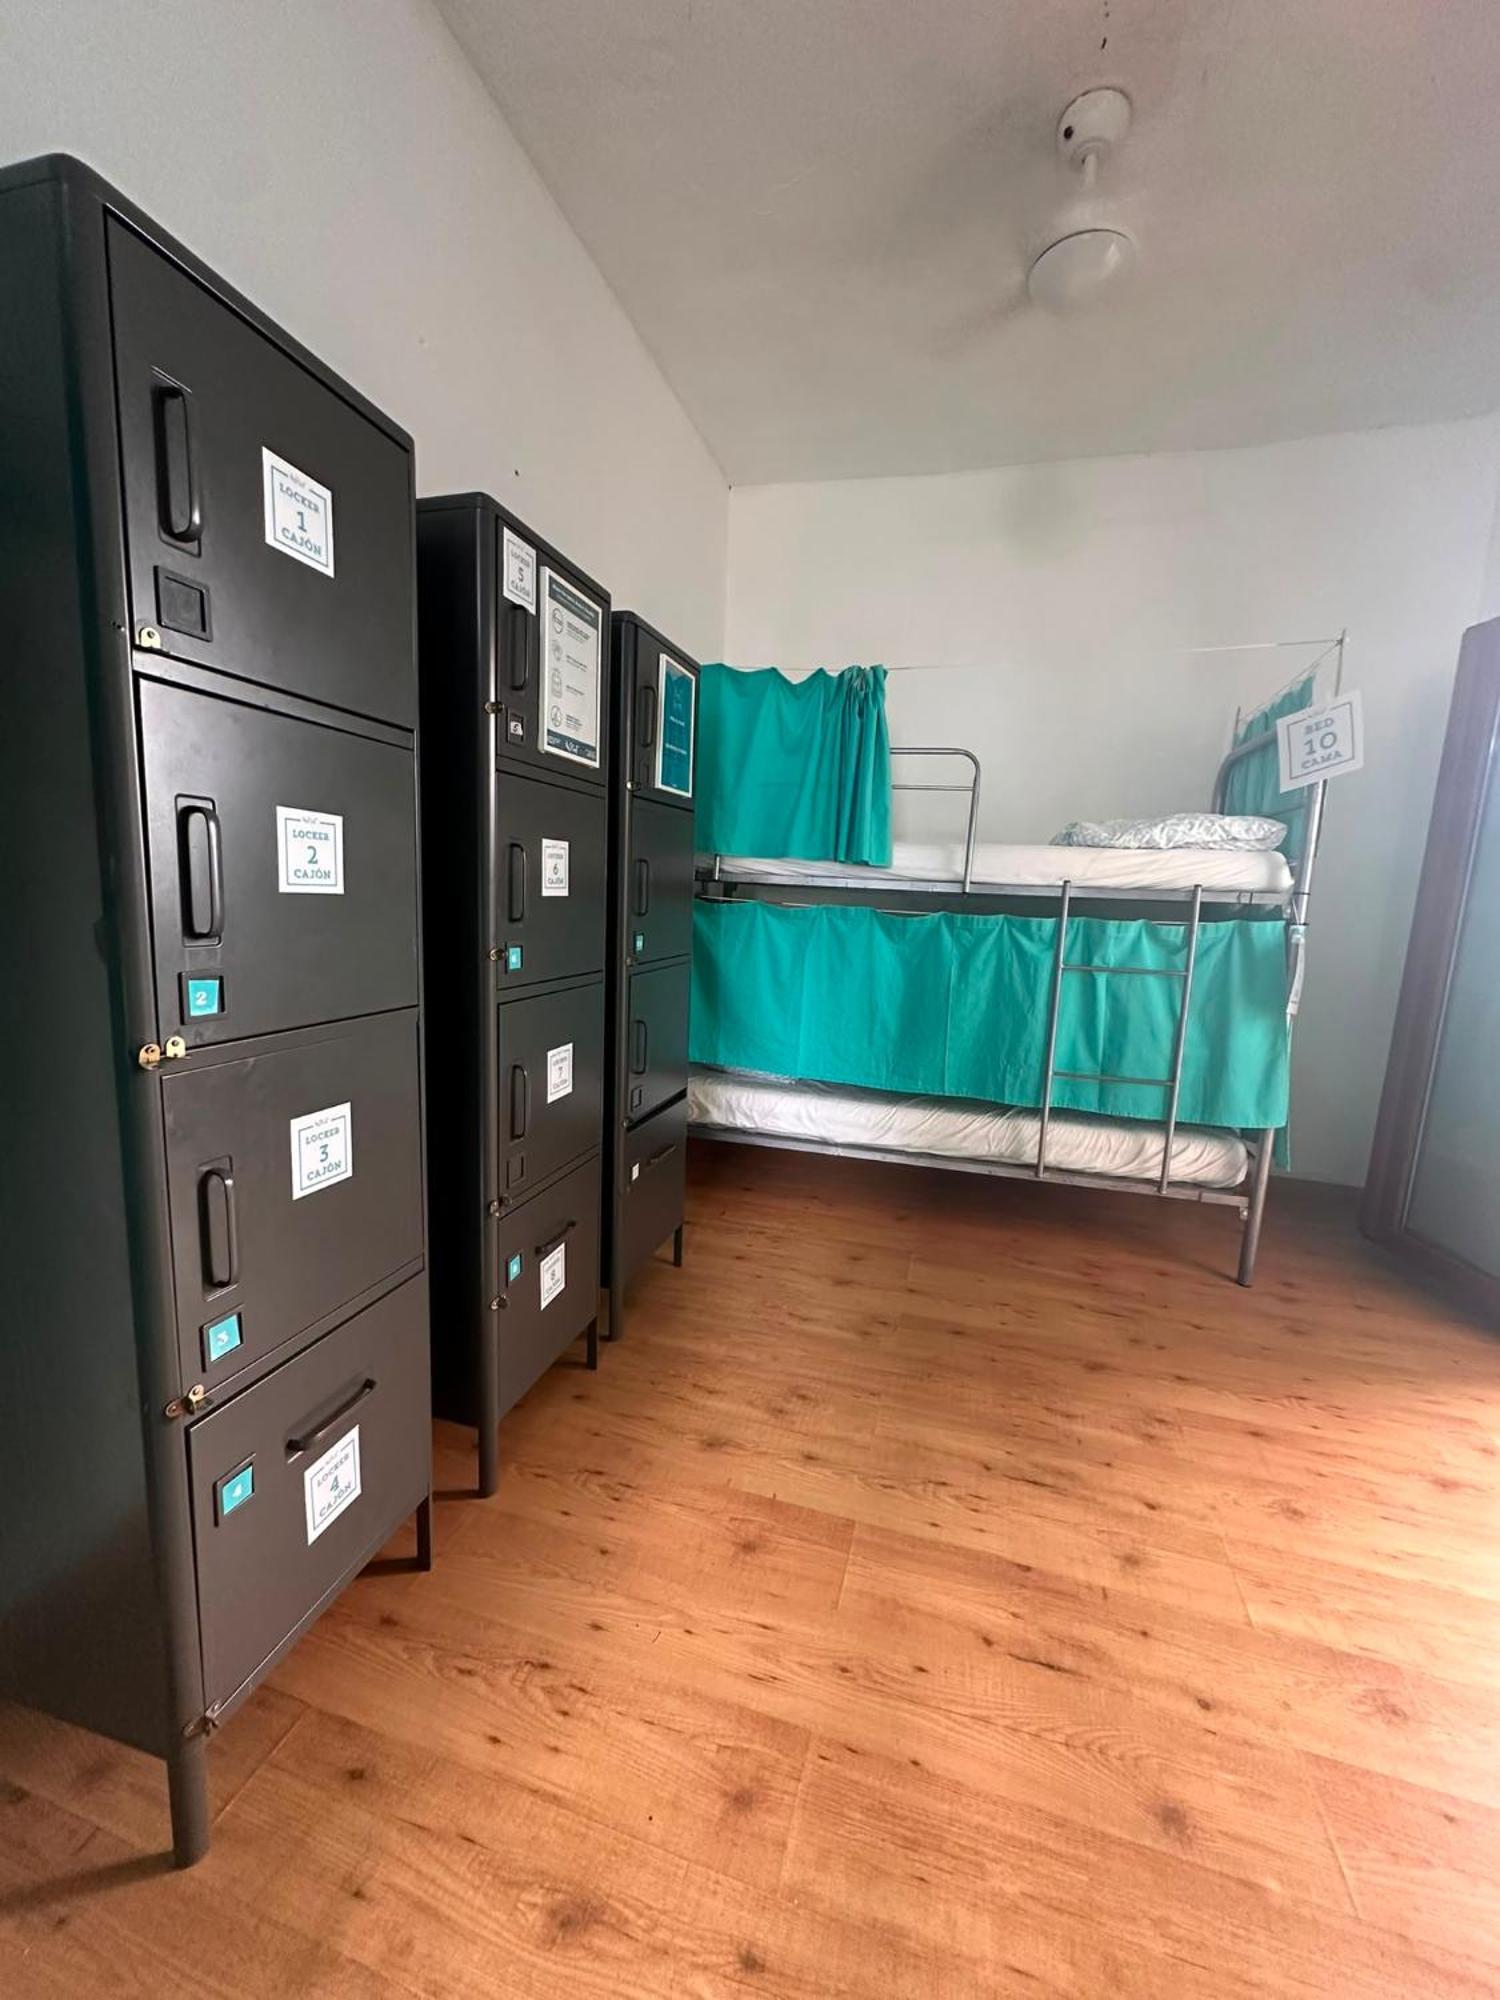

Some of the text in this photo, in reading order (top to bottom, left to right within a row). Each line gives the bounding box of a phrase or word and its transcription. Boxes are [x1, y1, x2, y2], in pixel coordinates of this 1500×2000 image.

[279, 482, 320, 513] LOCKER
[297, 511, 307, 533] 1
[281, 527, 322, 556] CAJÓN
[518, 566, 524, 583] 5
[1304, 717, 1335, 736] BED
[1303, 732, 1338, 756] 10
[1301, 750, 1343, 770] CAMA
[292, 829, 330, 841] LOCKER
[307, 845, 318, 865] 2
[293, 868, 331, 880] CAJÓN
[553, 863, 559, 876] 6
[195, 991, 208, 1006] 2
[305, 1127, 340, 1145] LOCKER
[320, 1143, 329, 1163] 3
[307, 1160, 342, 1181] CAJÓN
[317, 1453, 350, 1488] LOCKER
[330, 1475, 339, 1492] 4
[319, 1482, 352, 1518] CAJÓN
